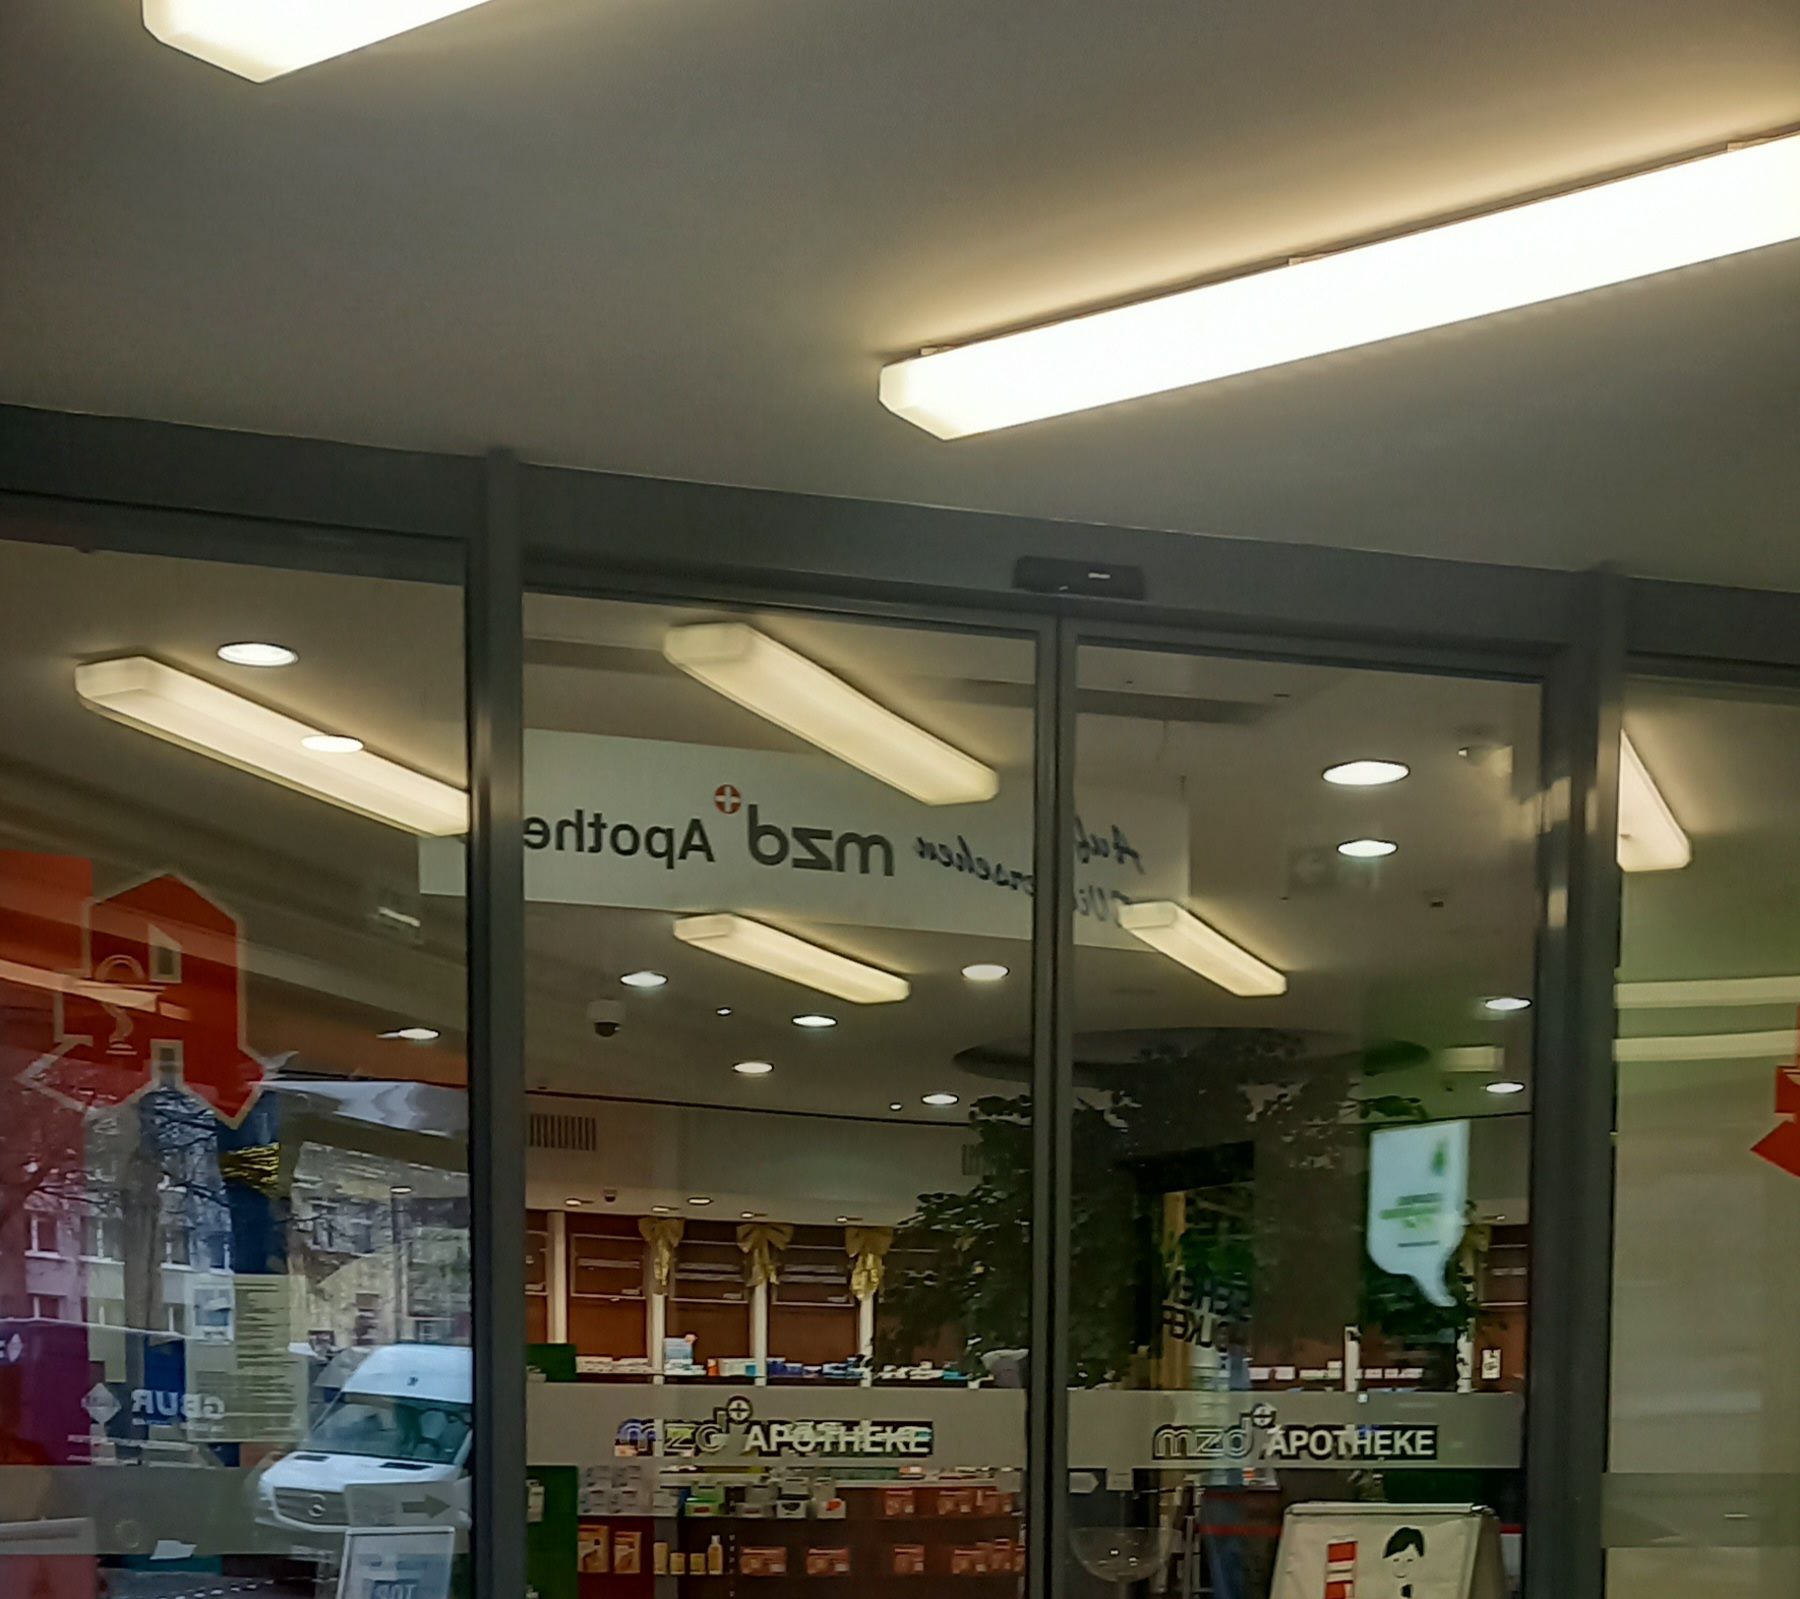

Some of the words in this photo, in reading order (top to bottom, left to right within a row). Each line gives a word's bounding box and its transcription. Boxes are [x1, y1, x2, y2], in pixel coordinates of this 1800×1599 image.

[615, 1407, 728, 1456] mzd
[744, 1421, 933, 1457] APOTHEKE
[1152, 1413, 1255, 1459] mzd
[1259, 1426, 1437, 1460] APOTHEKE
